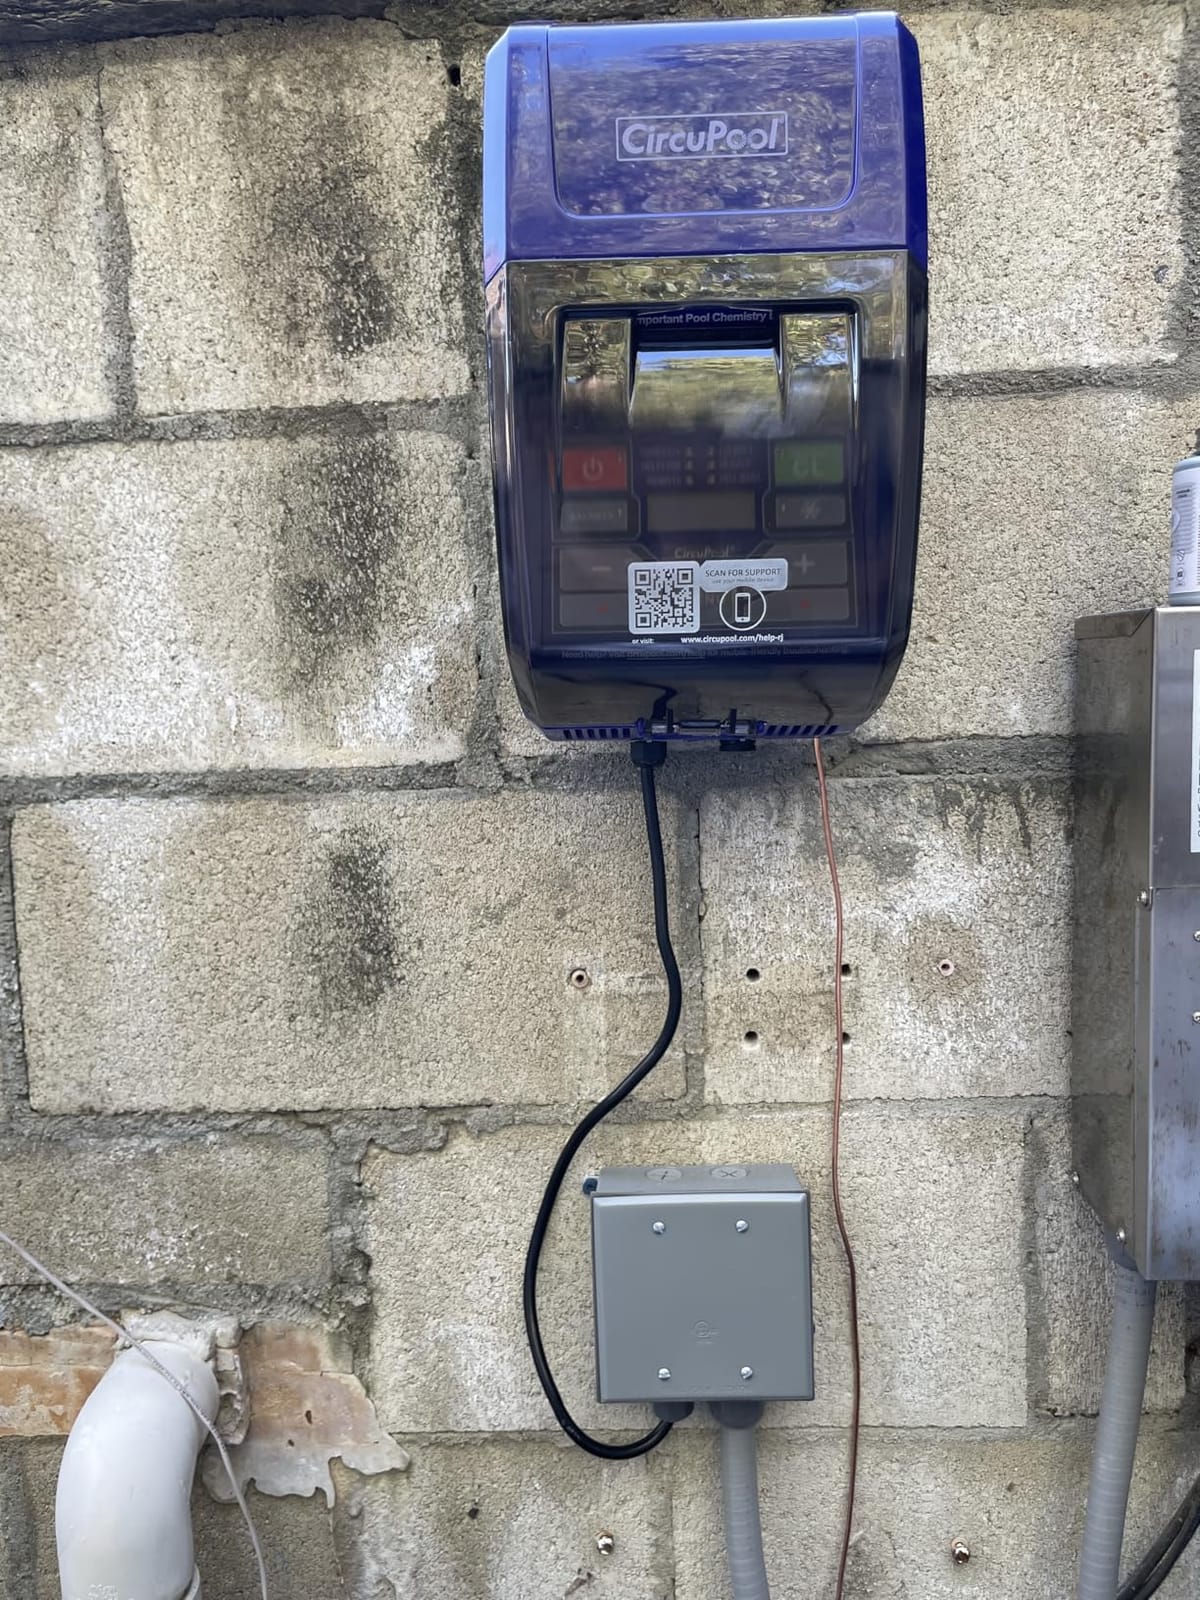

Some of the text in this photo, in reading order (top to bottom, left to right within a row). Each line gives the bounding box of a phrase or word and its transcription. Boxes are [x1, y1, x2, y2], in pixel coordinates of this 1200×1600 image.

[622, 118, 780, 154] CircuPool
[636, 314, 684, 327] mportant
[685, 312, 710, 323] Pool
[712, 311, 767, 323] Chemistry
[705, 567, 780, 578] SCAN FOR SUPPORT
[680, 633, 784, 645] www.circupool.com/help-rj
